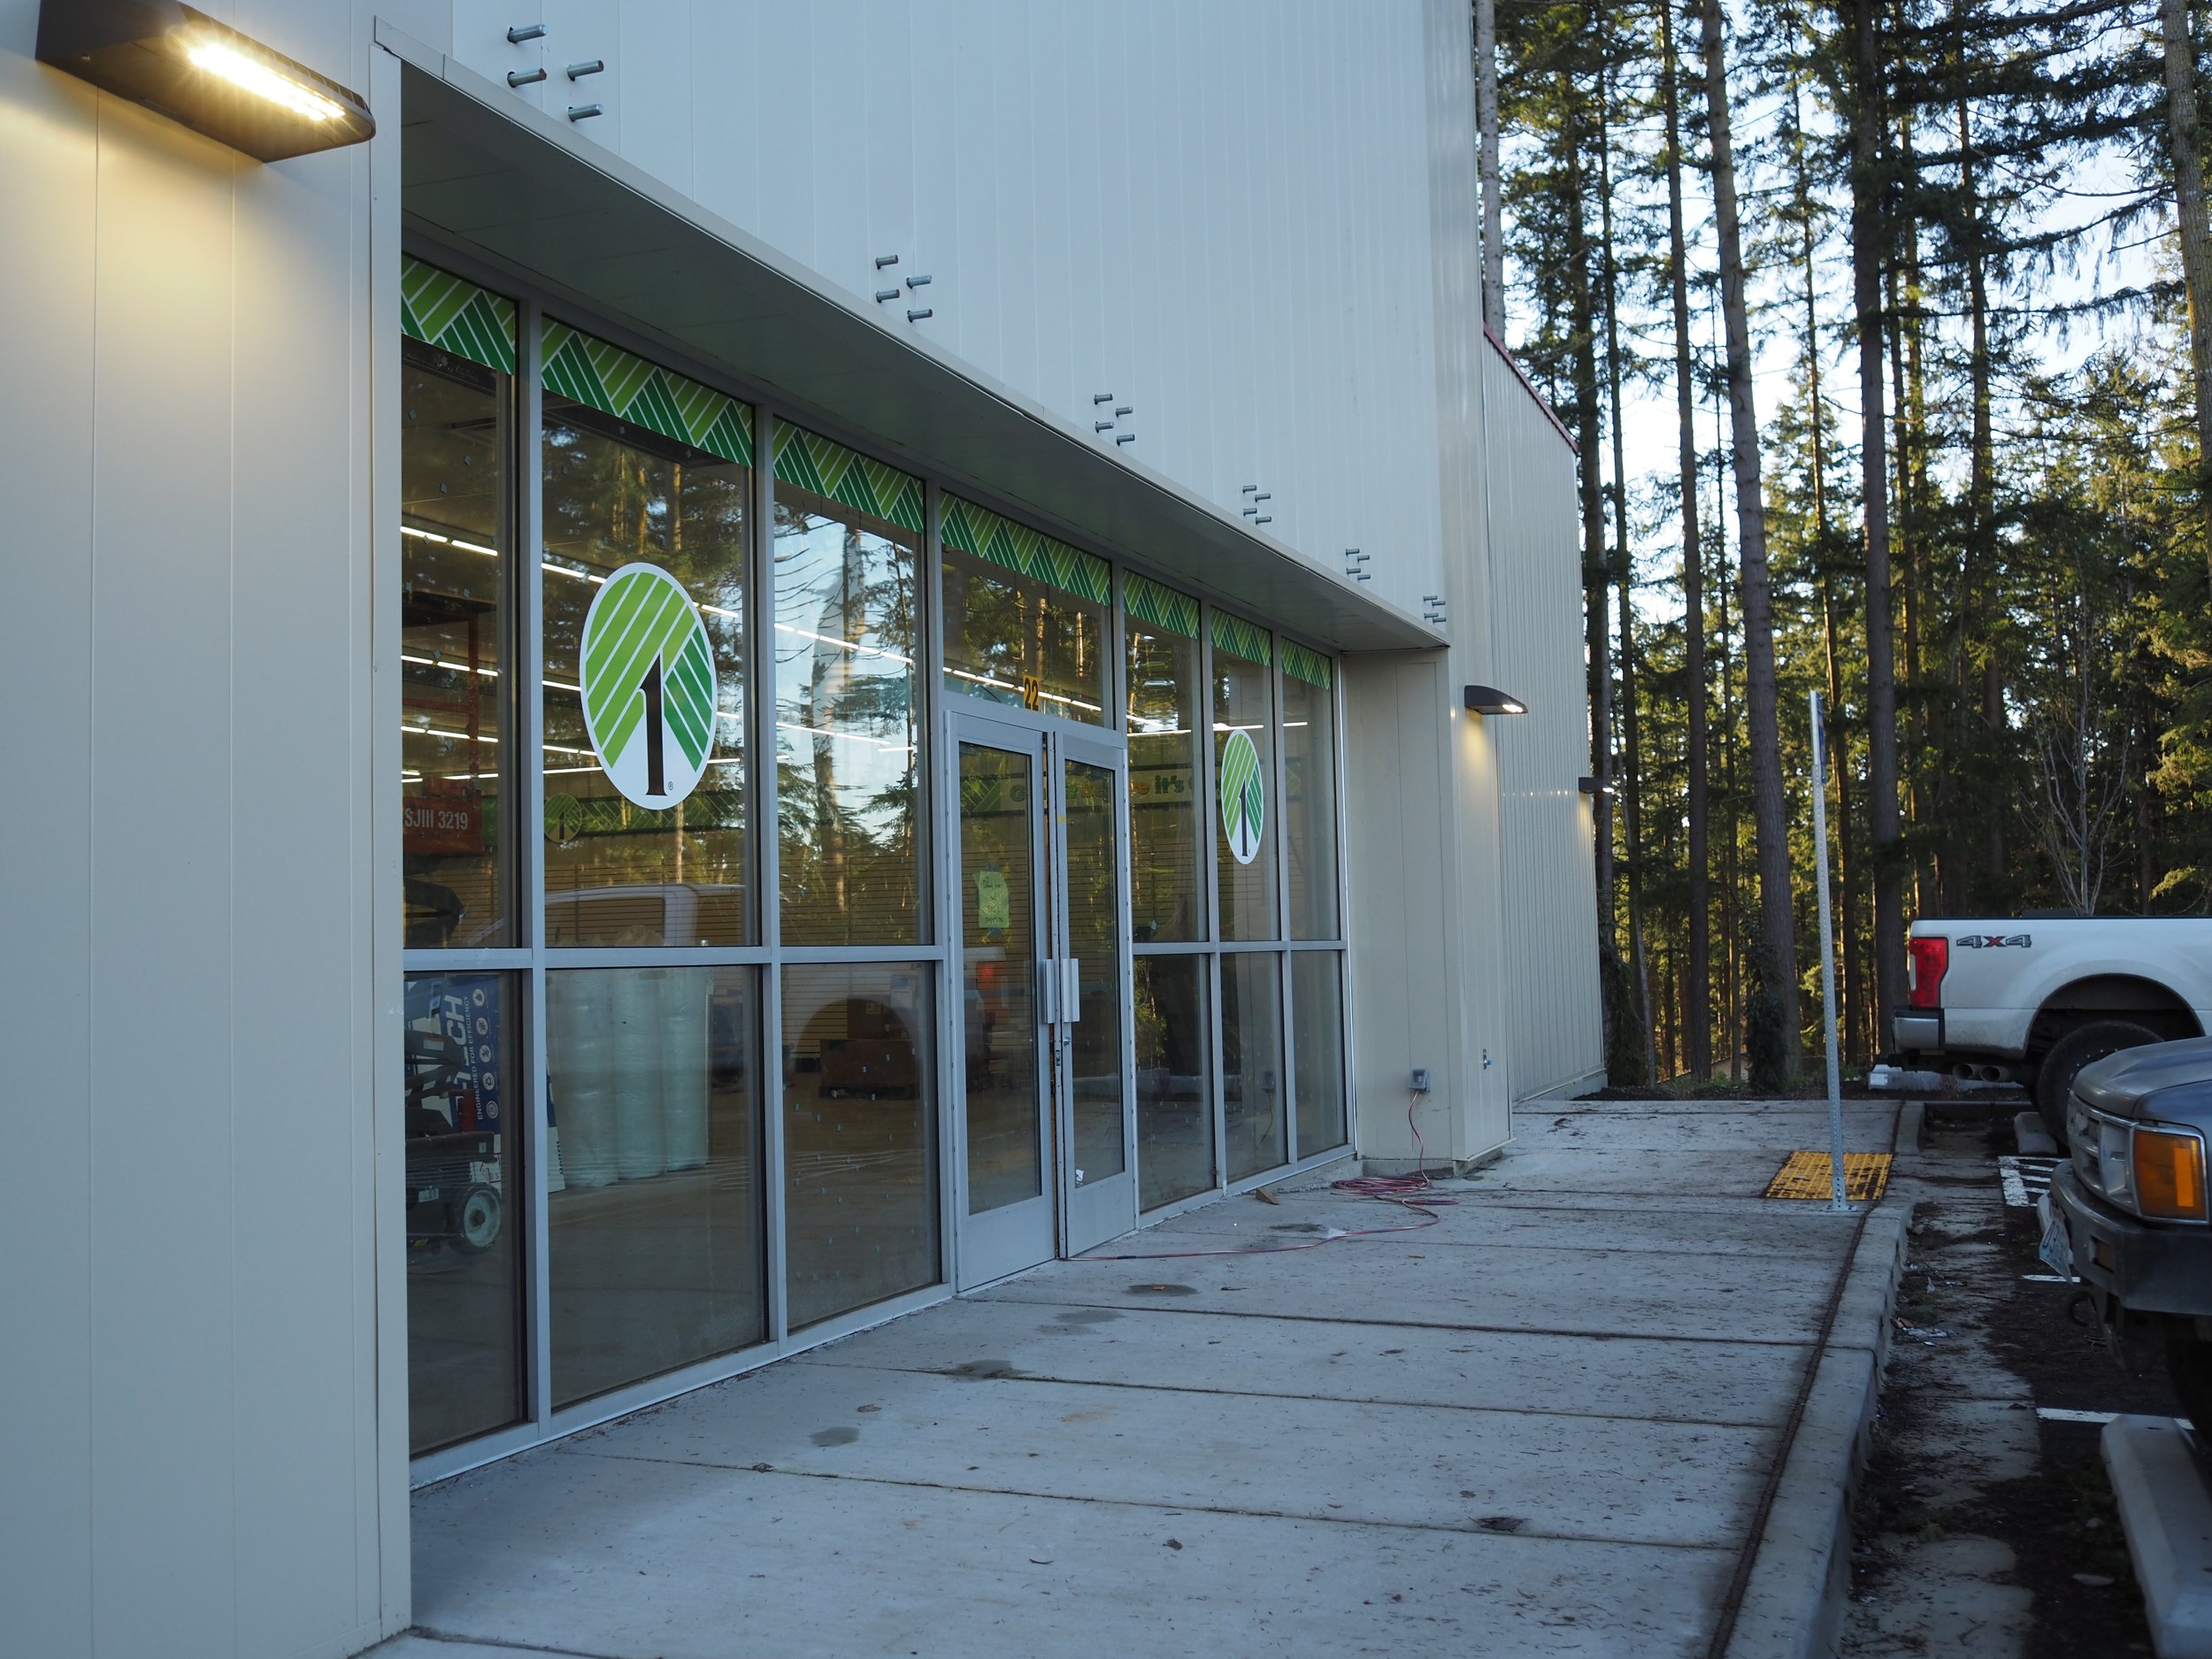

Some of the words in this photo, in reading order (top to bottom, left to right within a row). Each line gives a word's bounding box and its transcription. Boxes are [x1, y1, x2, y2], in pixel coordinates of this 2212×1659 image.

[1025, 678, 1039, 711] 22
[438, 811, 467, 830] 3219
[462, 996, 475, 1045] EFFICIENCY
[468, 1046, 477, 1065] FOR
[471, 1066, 483, 1120] ENGINEERED
